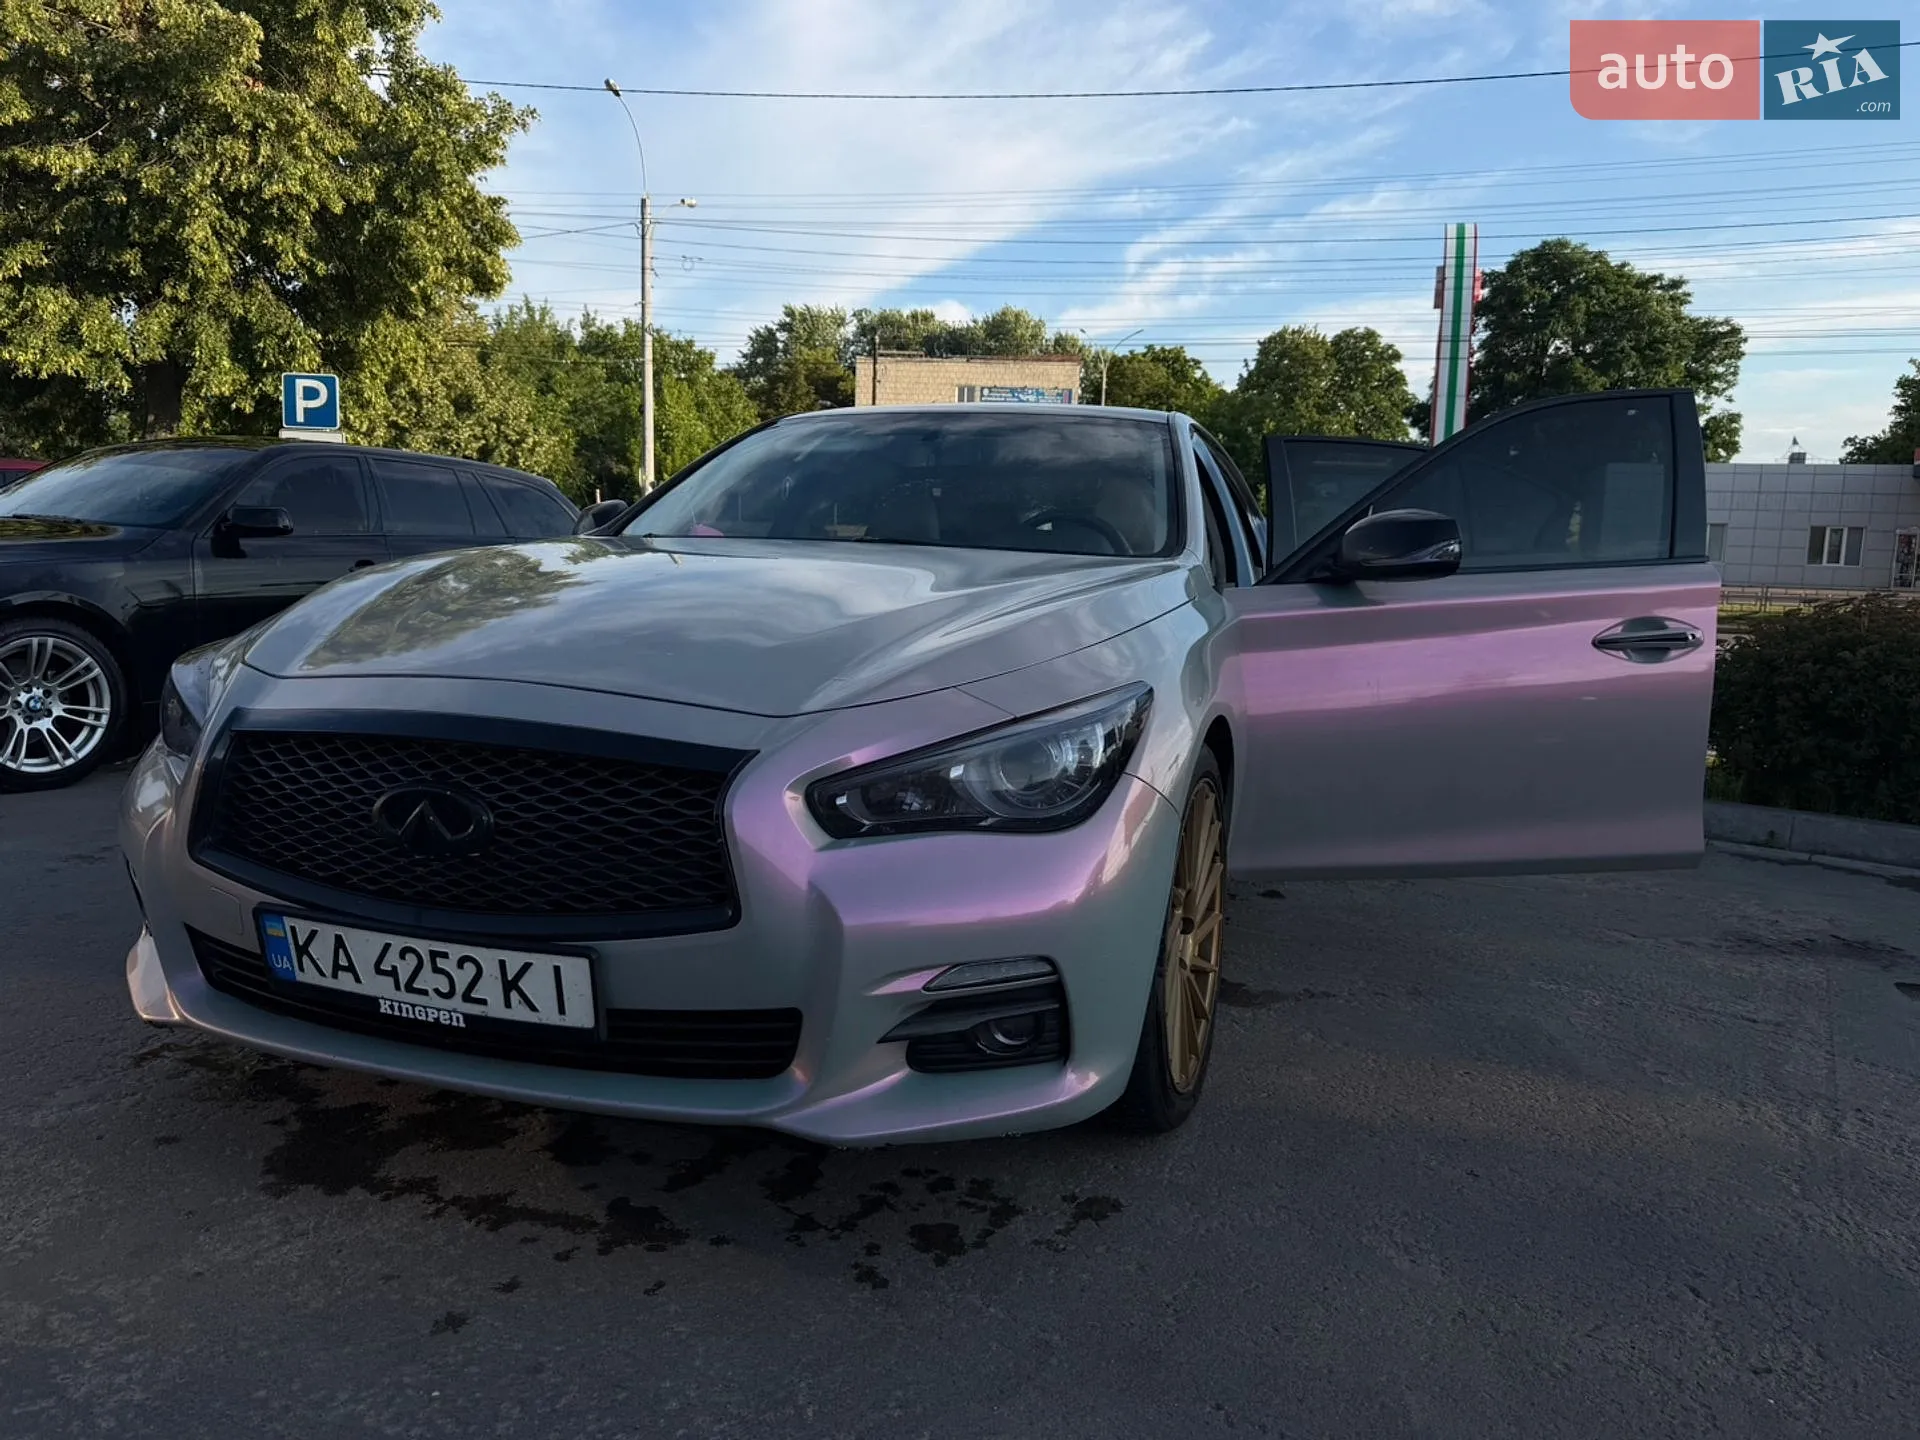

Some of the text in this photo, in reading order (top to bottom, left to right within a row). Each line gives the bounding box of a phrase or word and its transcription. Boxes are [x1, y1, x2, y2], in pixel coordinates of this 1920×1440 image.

[295, 378, 328, 423] P
[271, 952, 293, 972] UA
[289, 924, 568, 1016] KA 4252 KI
